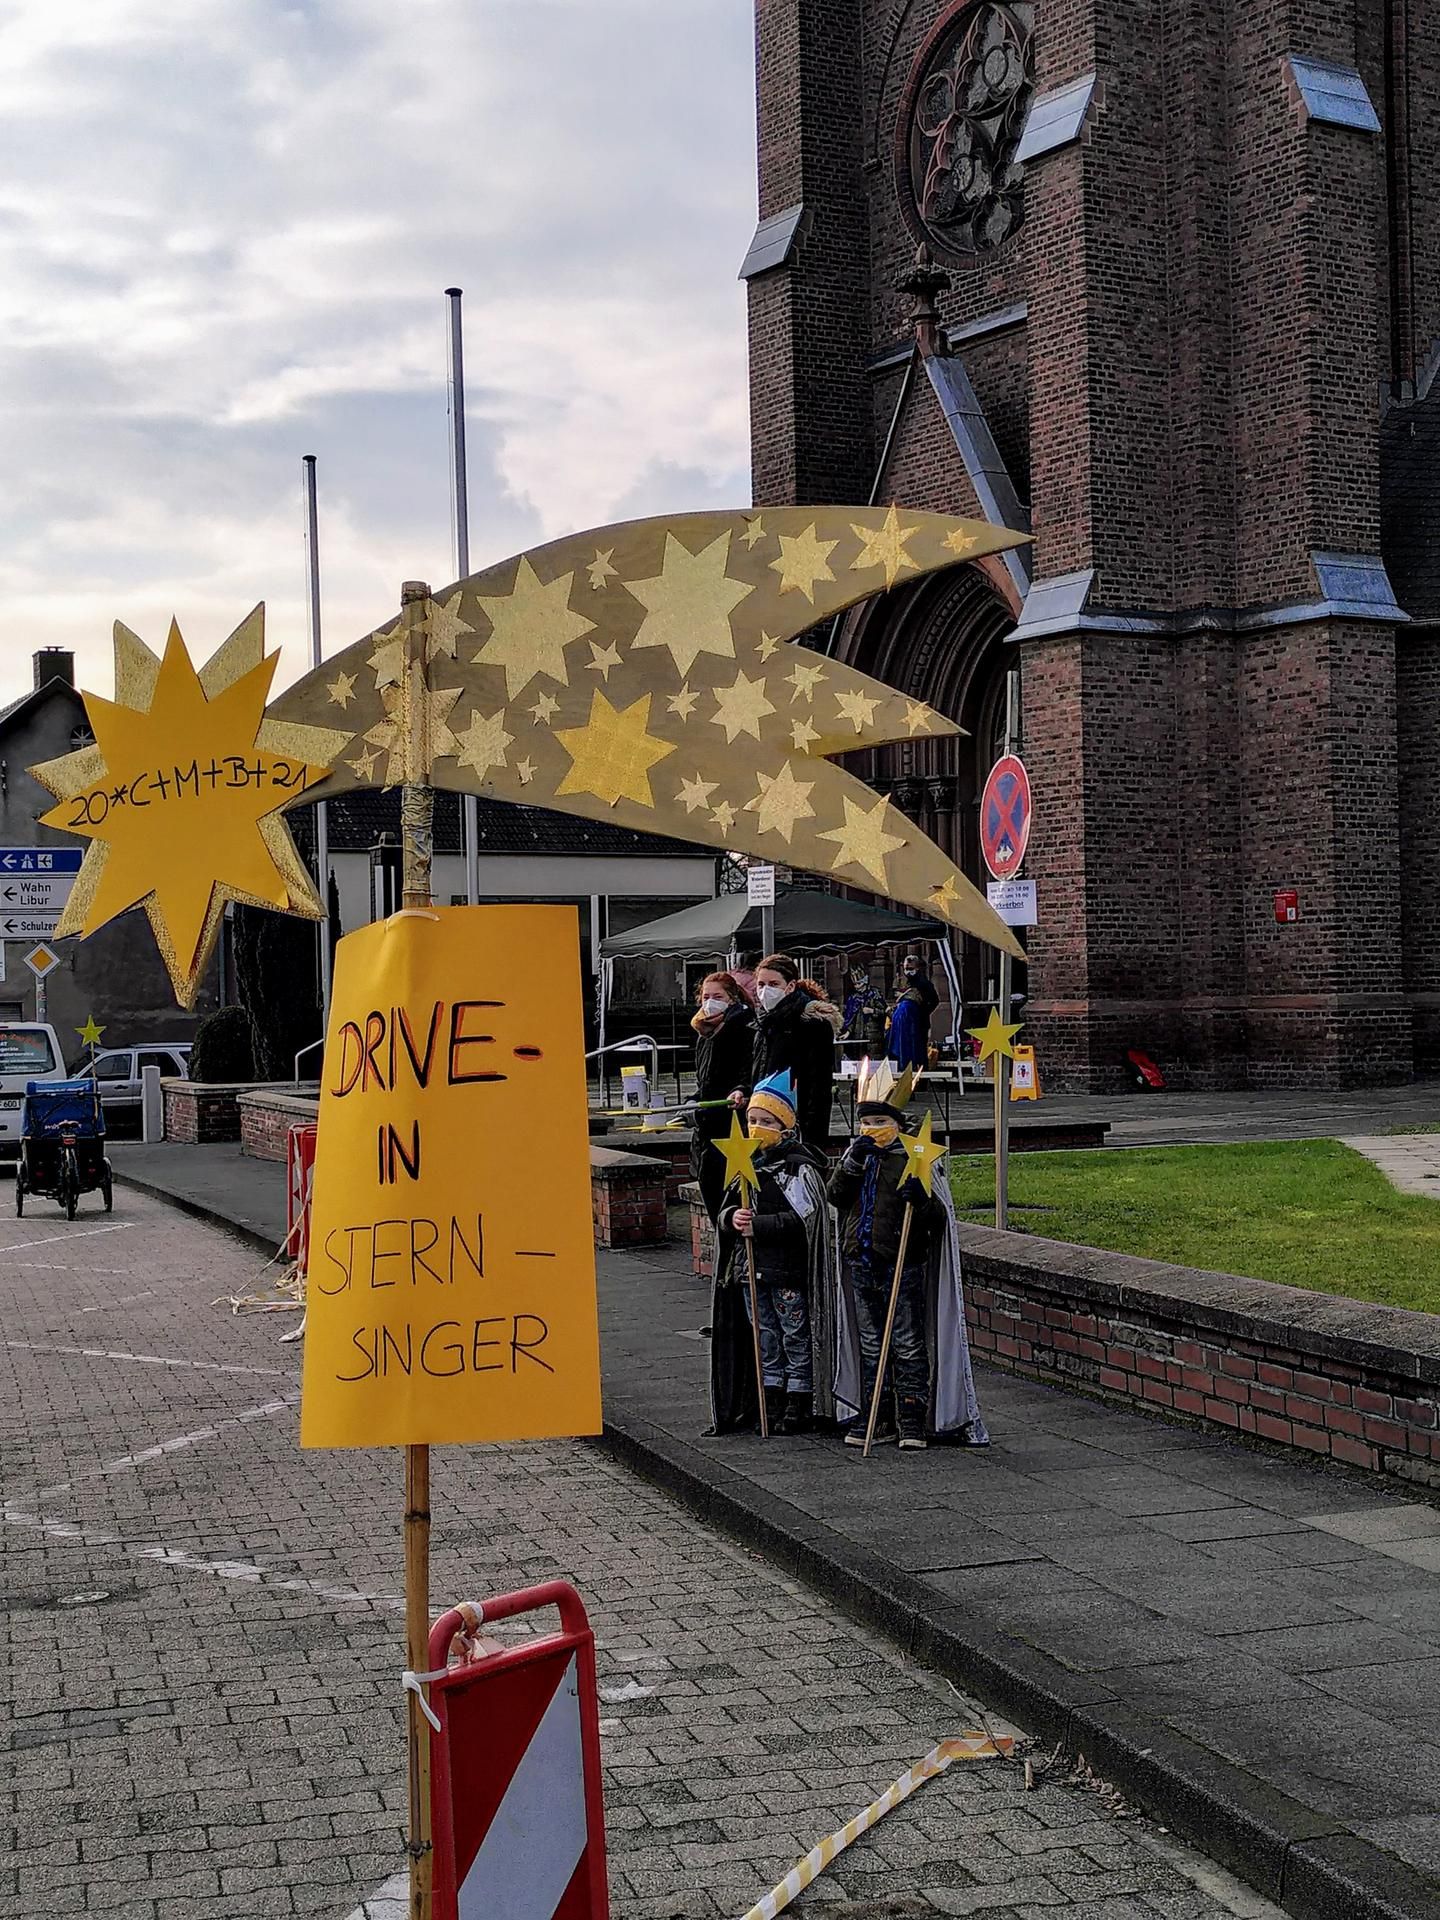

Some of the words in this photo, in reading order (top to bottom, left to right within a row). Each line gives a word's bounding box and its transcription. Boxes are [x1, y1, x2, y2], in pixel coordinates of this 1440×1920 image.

[20, 883, 51, 893] Wahn
[20, 895, 50, 905] Libur
[378, 1119, 420, 1185] IN
[336, 1314, 555, 1381] SINGER
